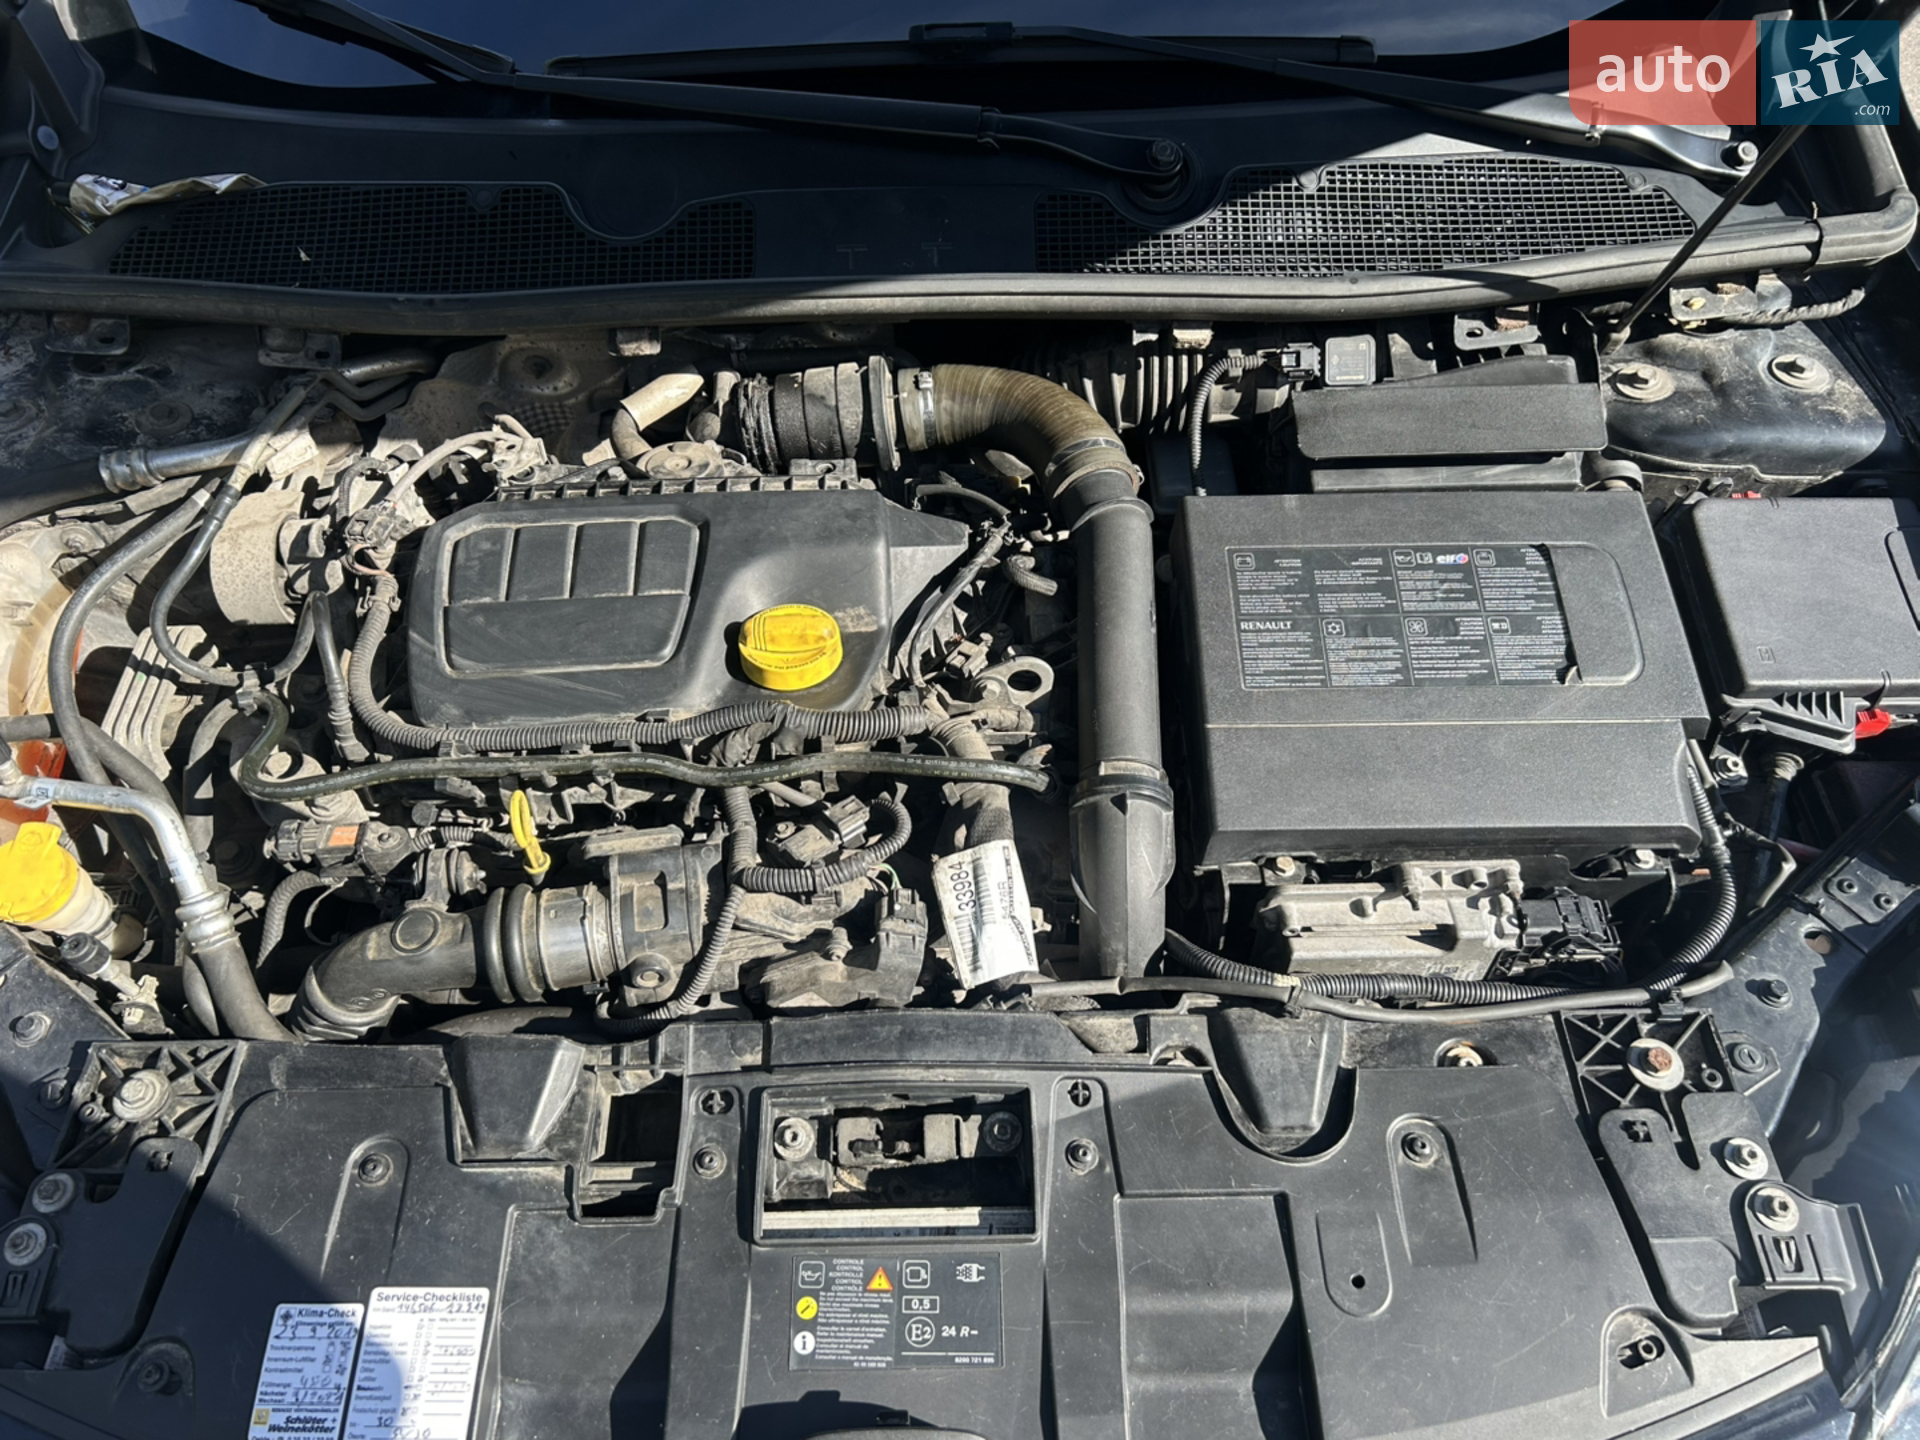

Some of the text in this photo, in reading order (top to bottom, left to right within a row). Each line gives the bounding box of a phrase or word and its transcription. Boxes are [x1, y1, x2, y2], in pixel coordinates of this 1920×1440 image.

[1436, 554, 1456, 563] elf
[1240, 621, 1292, 630] RENAULT
[948, 861, 977, 911] 33984
[376, 1292, 483, 1302] Service-Checkliste
[911, 1298, 931, 1310] 0,5
[297, 1308, 356, 1318] Klima-Check
[911, 1323, 932, 1341] E2
[941, 1325, 957, 1337] 24
[283, 1415, 328, 1424] Schlüter
